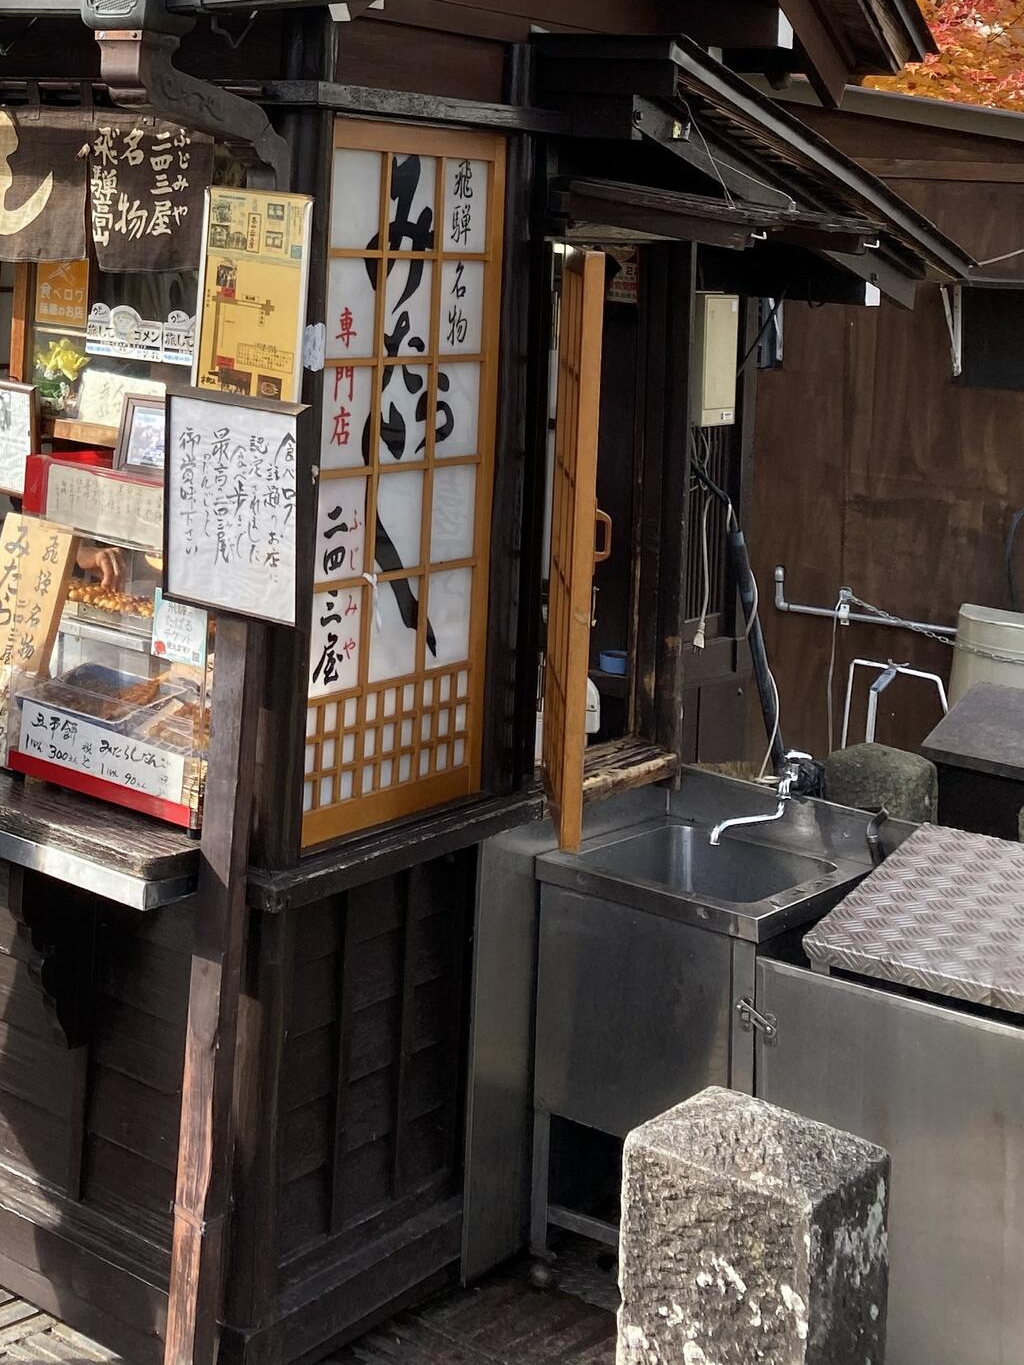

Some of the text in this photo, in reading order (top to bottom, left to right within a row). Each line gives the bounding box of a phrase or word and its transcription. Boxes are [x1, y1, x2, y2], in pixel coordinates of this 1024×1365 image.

[115, 128, 148, 241] 名物
[145, 132, 174, 236] 二四三屋
[172, 128, 191, 226] ふじみや
[39, 282, 84, 303] 食べログ
[330, 306, 357, 447] 専門店
[312, 504, 349, 686] 二四三屋
[343, 510, 362, 660] ふじみや
[31, 713, 79, 747] 五平餅
